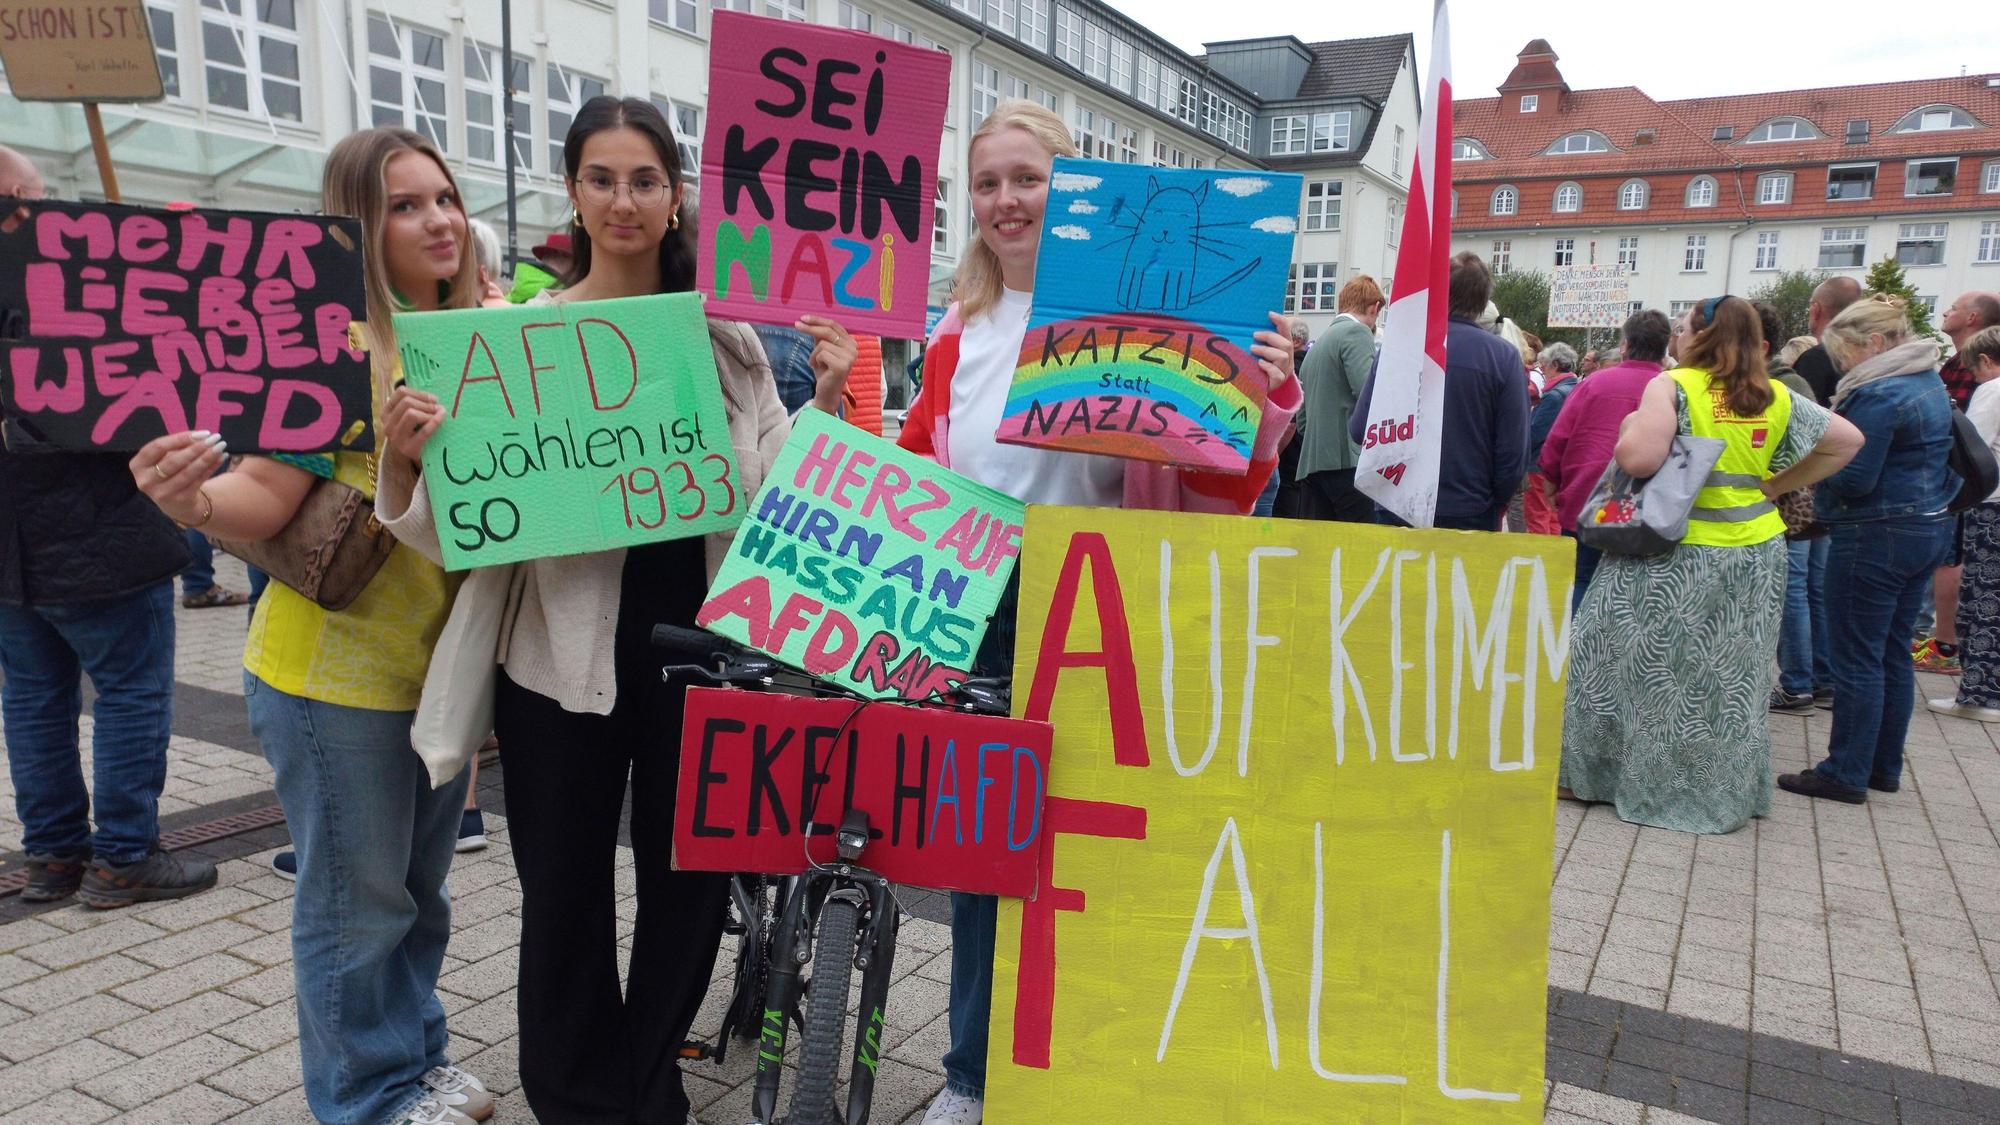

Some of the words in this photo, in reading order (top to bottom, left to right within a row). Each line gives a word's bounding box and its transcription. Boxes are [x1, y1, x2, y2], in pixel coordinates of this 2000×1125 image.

[723, 124, 921, 243] KEIN
[36, 211, 322, 289] MeHR
[714, 219, 895, 312] NAZi
[452, 318, 638, 418] AFD
[1041, 325, 1239, 385] KATZIS
[91, 370, 342, 451] AFD
[1022, 396, 1178, 437] NAZIS
[449, 497, 520, 551] SO
[602, 454, 736, 529] 1933
[757, 486, 883, 566] HIRN
[881, 554, 969, 609] AN
[793, 433, 950, 542] HERZ
[934, 506, 1023, 577] AUF
[695, 575, 858, 675] AFD
[740, 526, 864, 605] HASS
[857, 584, 975, 661] AUS
[1023, 531, 1298, 777] AUF
[1330, 547, 1574, 771] KEIMEN
[692, 717, 1042, 851] EKELHAFD
[1012, 795, 1520, 1101] FALL
